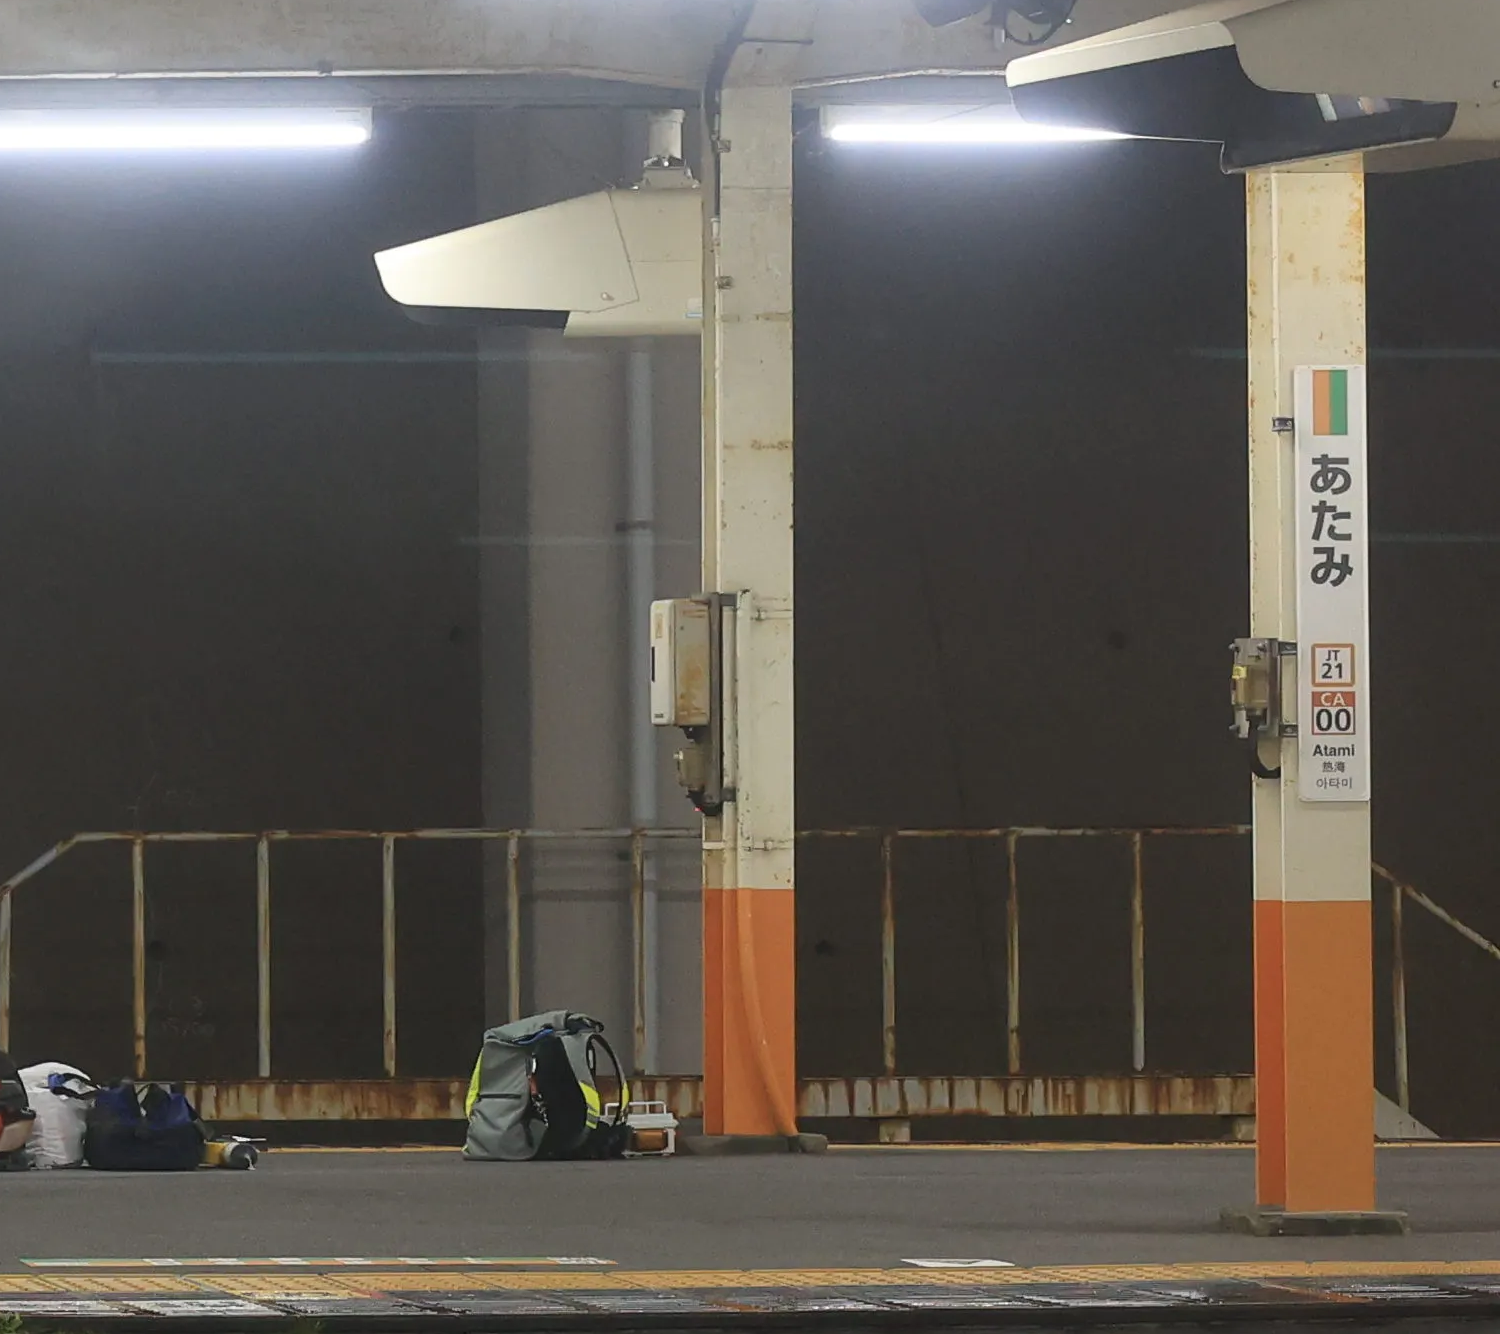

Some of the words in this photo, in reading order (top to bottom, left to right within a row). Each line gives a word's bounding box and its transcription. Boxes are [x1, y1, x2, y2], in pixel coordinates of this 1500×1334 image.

[1310, 454, 1354, 587] あたみ
[1326, 650, 1340, 662] JT
[1321, 663, 1345, 680] 21
[1320, 692, 1346, 707] CA
[1315, 708, 1352, 732] 00
[1313, 744, 1355, 757] Atami
[1316, 776, 1353, 790] 아타미
